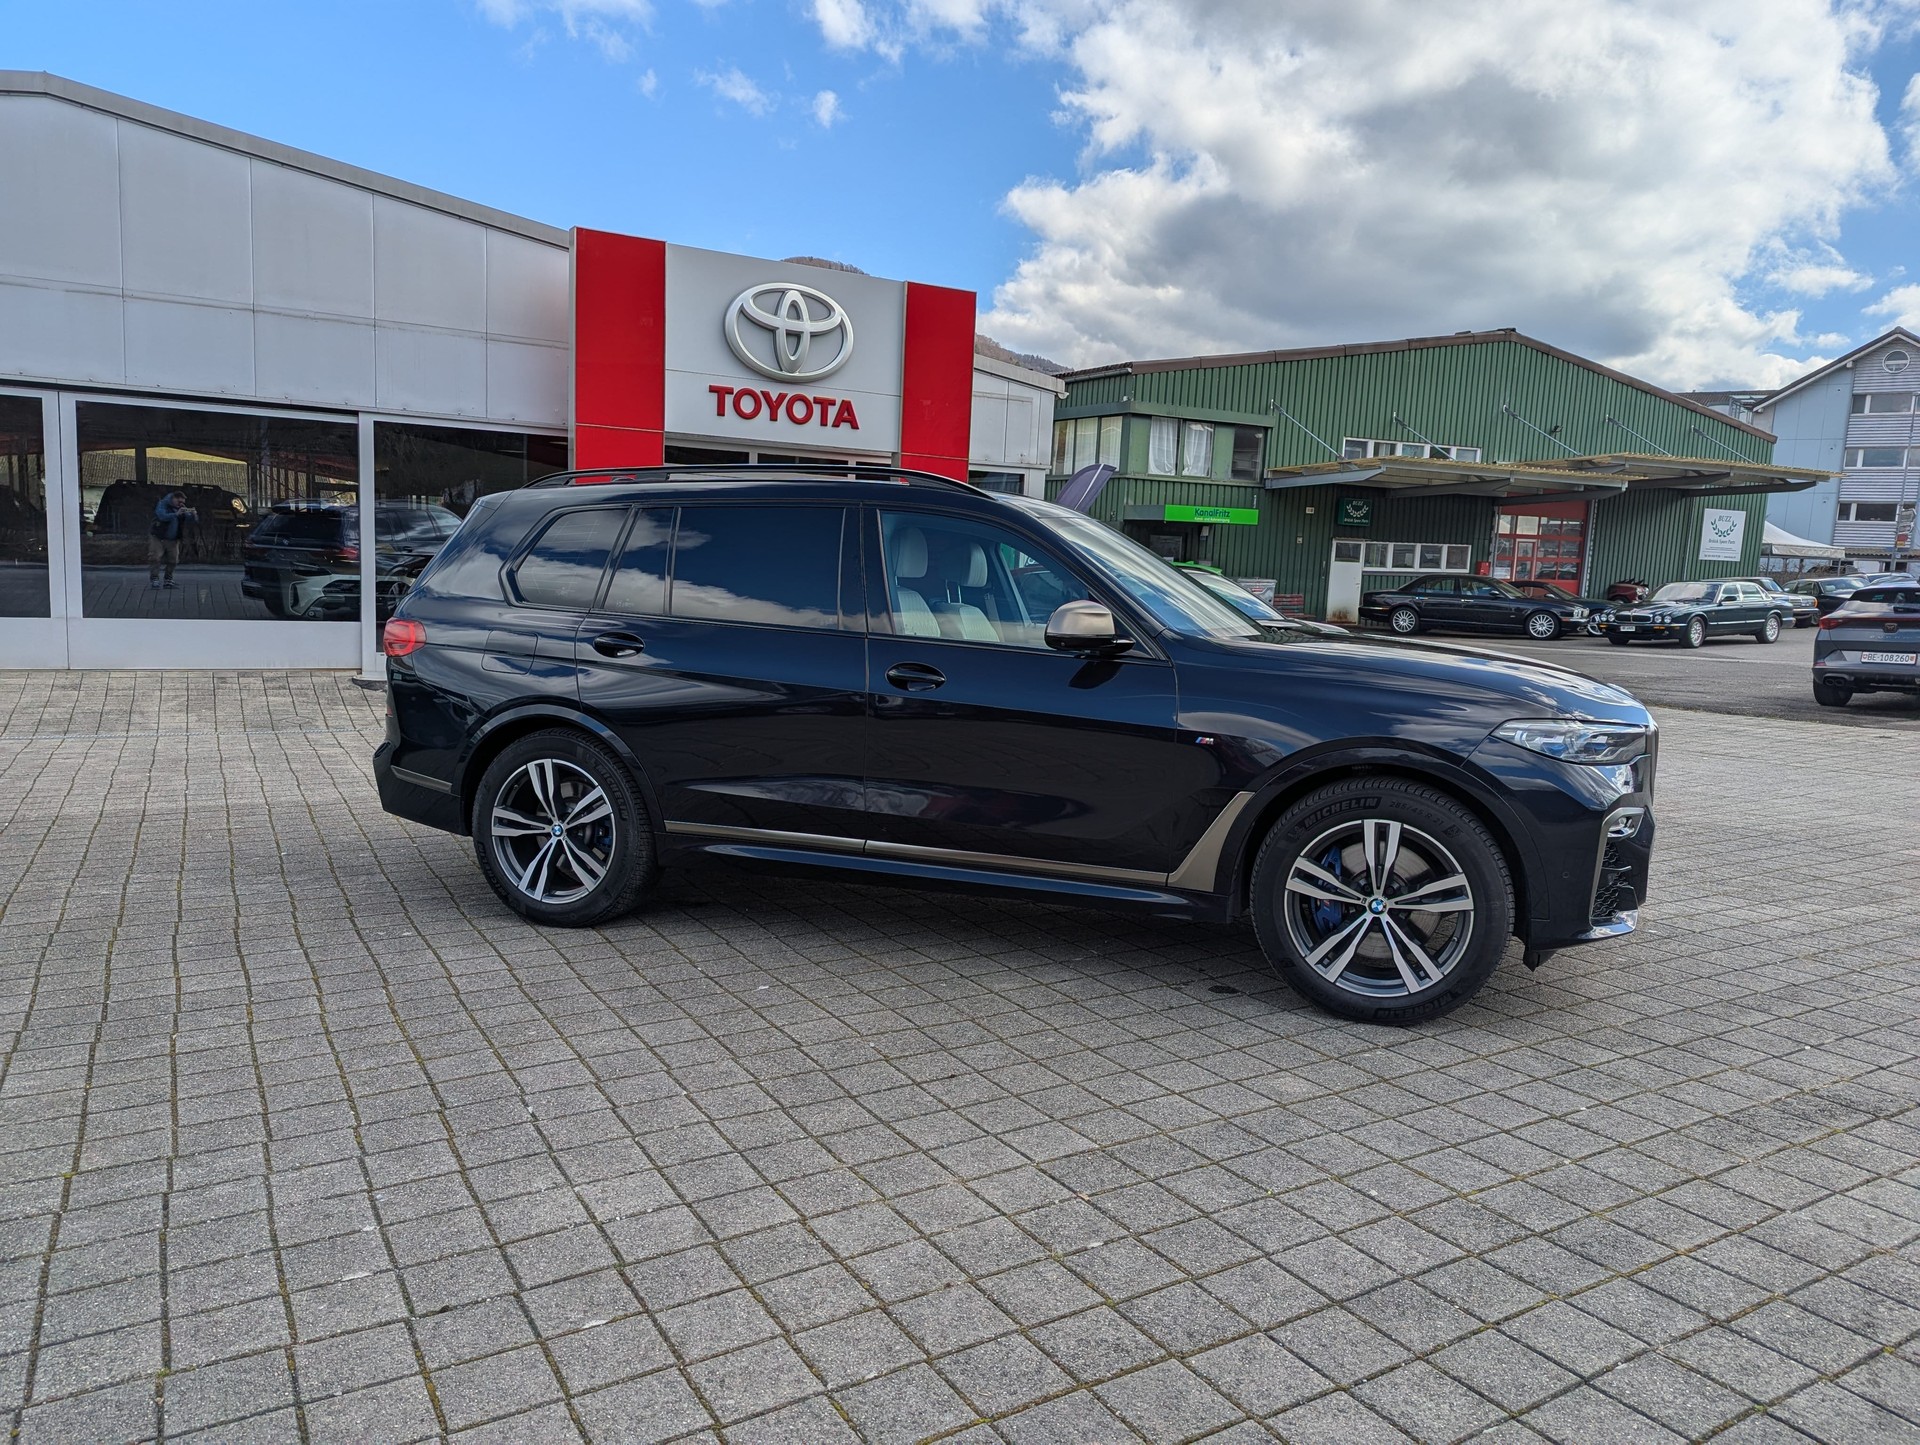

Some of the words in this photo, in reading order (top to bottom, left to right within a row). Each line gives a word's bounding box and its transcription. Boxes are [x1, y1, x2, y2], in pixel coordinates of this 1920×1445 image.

[708, 384, 860, 430] TOYOTA
[1194, 507, 1230, 518] KanalFritz
[1304, 798, 1378, 828] MICHELIN
